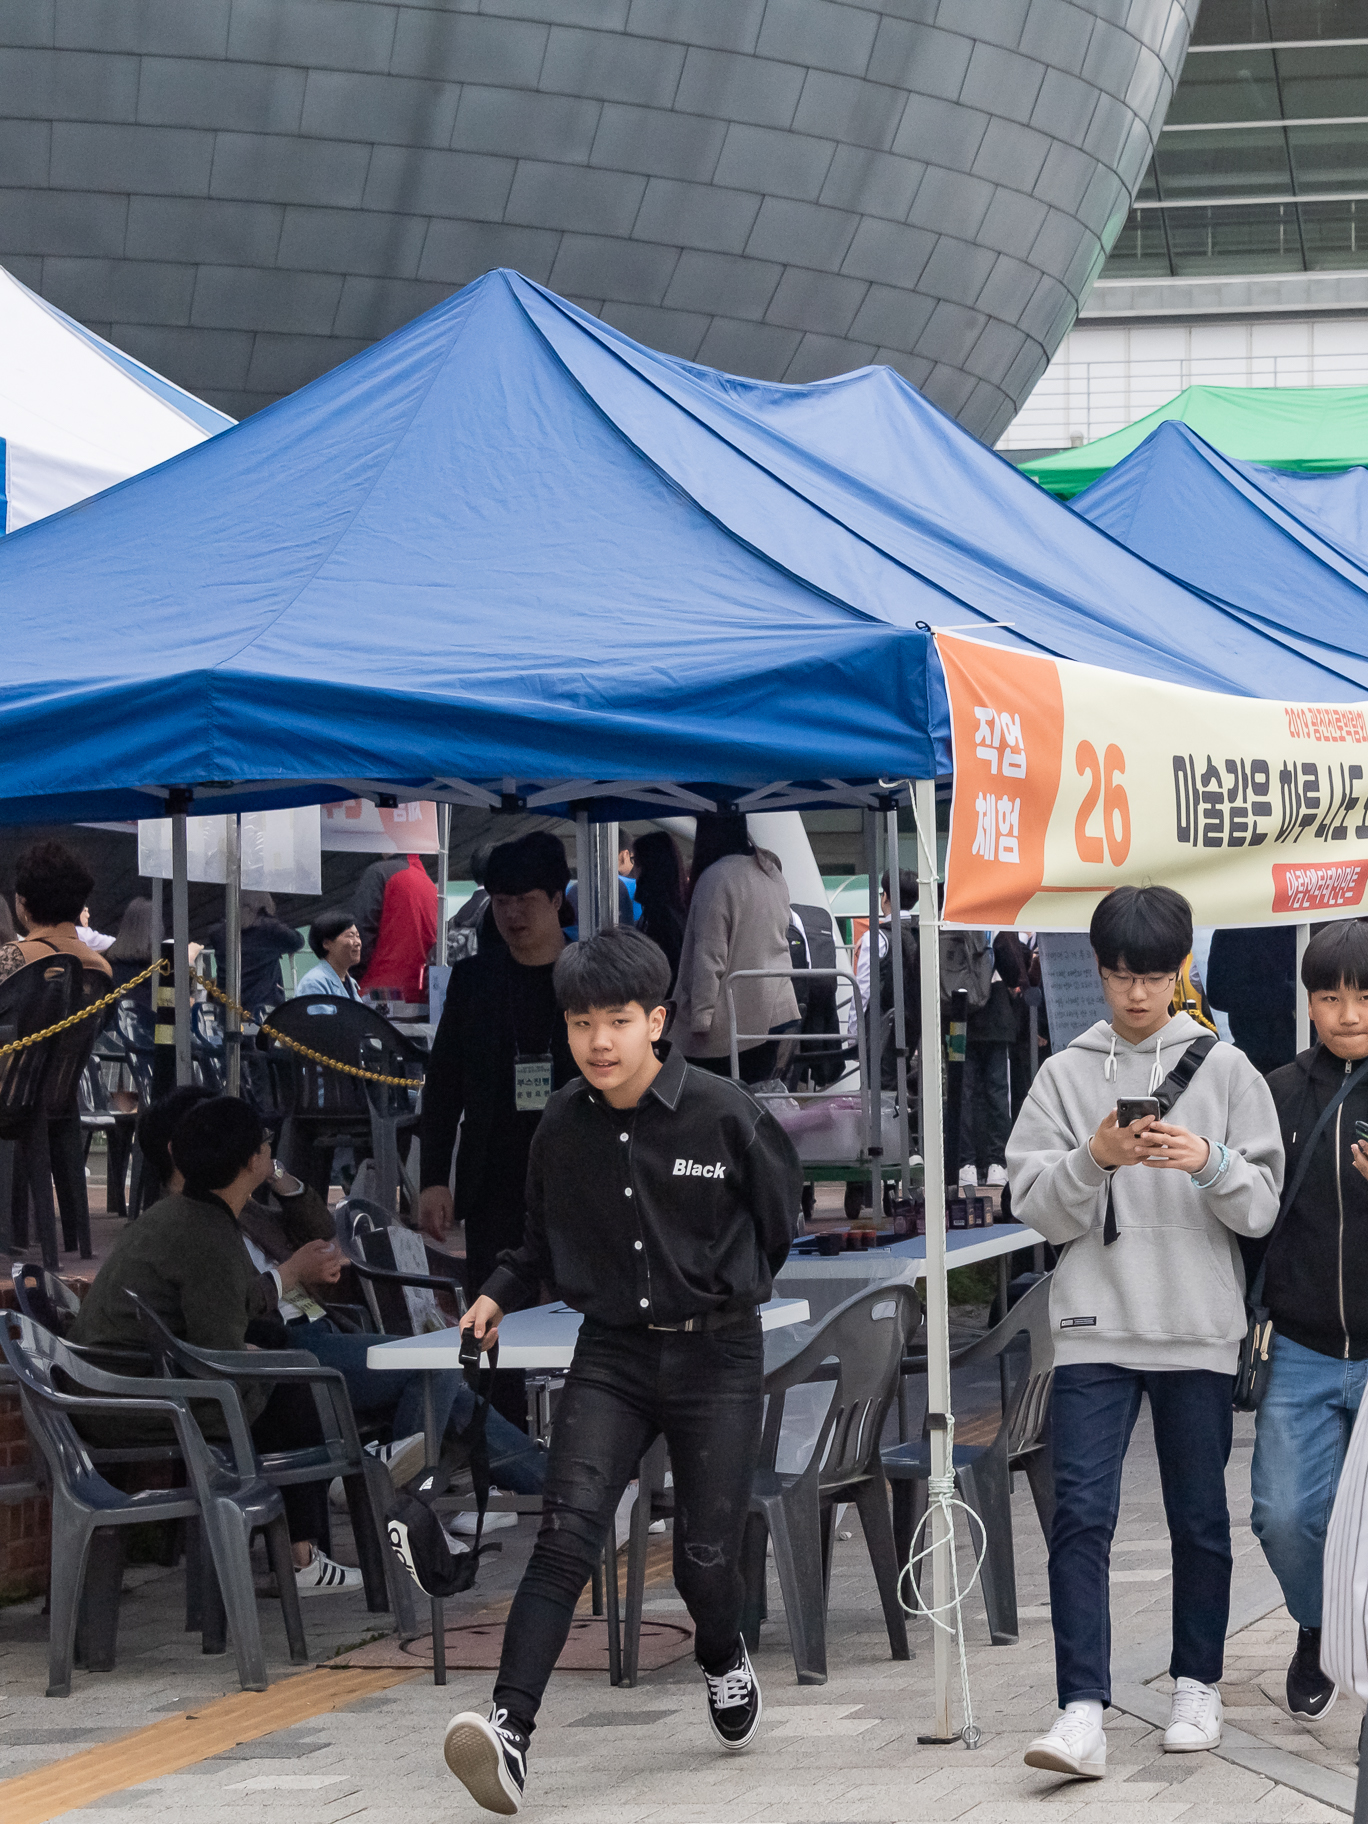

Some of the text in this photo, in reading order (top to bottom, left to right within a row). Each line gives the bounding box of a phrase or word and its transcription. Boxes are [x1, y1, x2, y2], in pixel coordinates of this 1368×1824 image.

[974, 706, 1026, 779] 직업
[1284, 707, 1311, 739] 2019
[972, 791, 1020, 864] 체험
[1075, 739, 1131, 867] 26
[1173, 753, 1272, 848] 마술같은
[1274, 760, 1321, 843] 하루
[1314, 762, 1363, 843] 나도
[672, 1158, 726, 1179] Black
